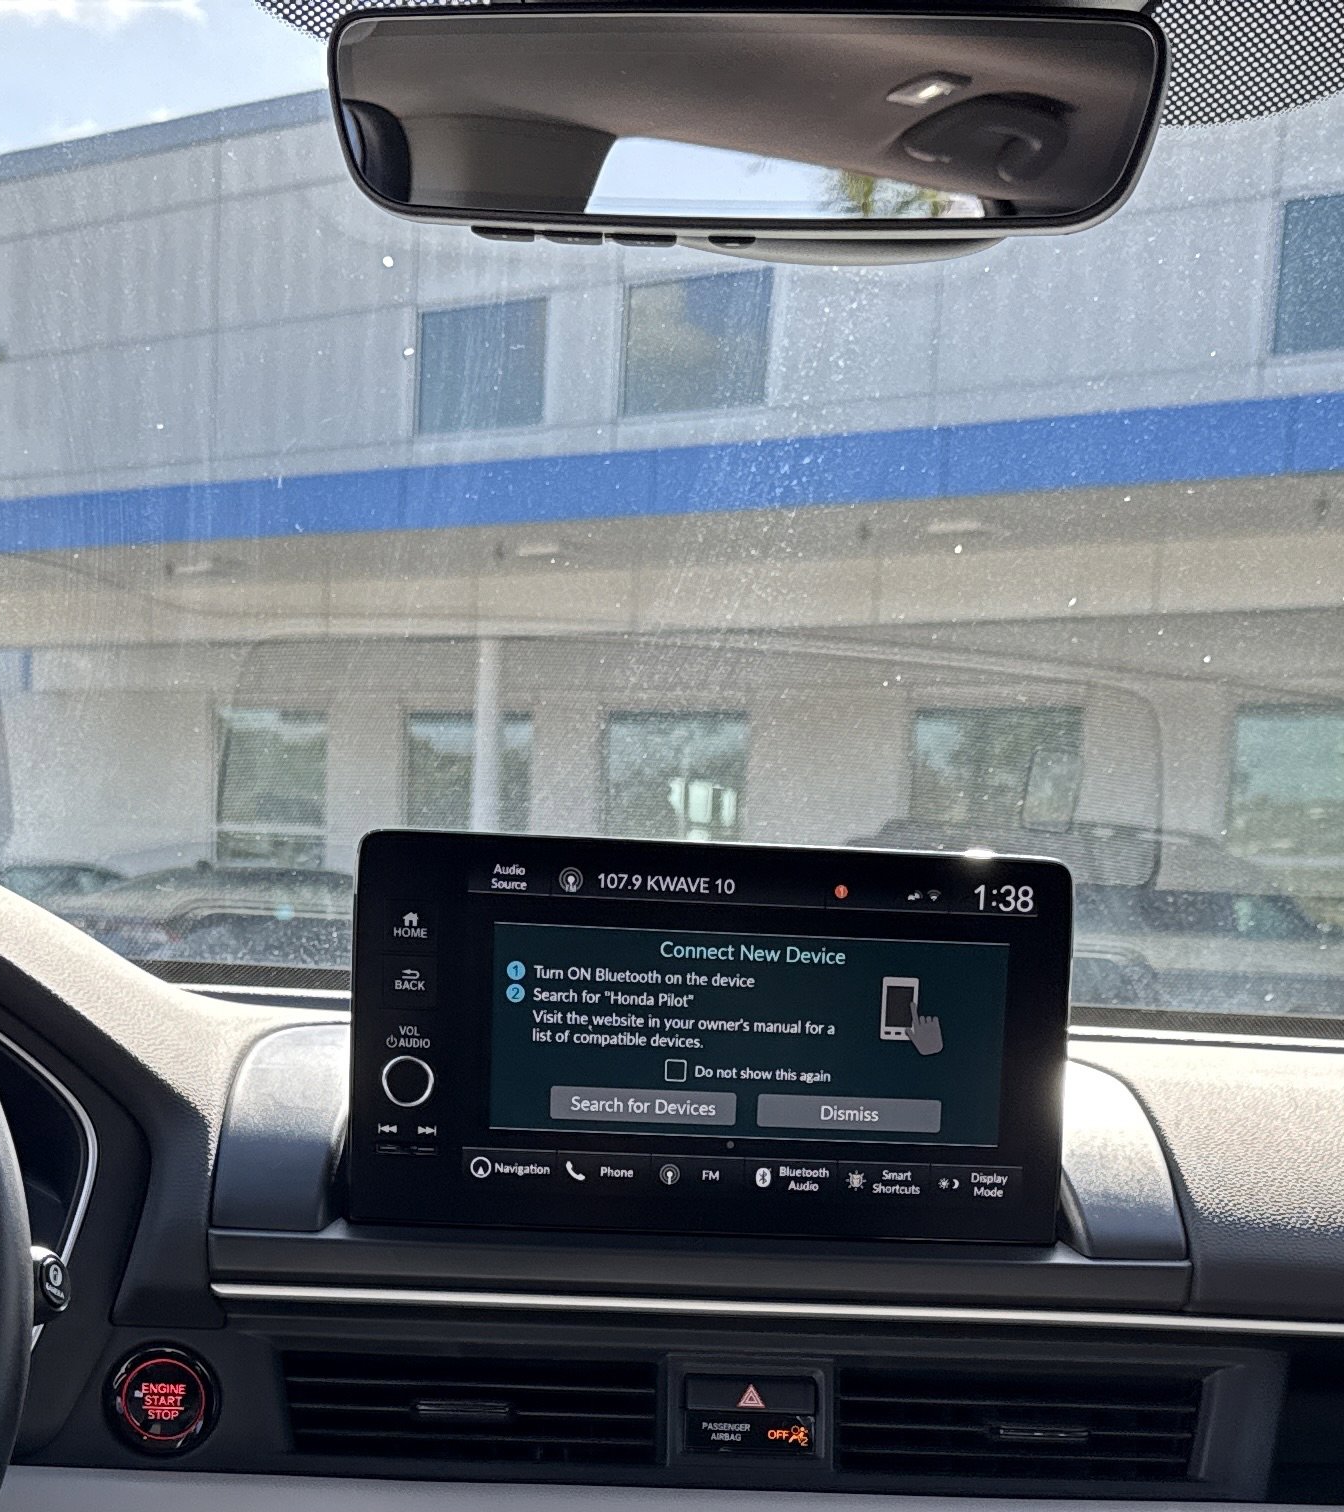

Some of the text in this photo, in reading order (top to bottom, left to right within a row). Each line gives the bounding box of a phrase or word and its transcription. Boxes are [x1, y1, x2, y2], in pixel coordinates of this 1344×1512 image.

[493, 863, 526, 876] Audio
[490, 878, 528, 891] Source
[597, 873, 736, 895] 107.9 KWAVE 10
[973, 884, 1034, 913] 1:38
[392, 927, 428, 939] HOME
[659, 941, 847, 966] Connect New Device
[533, 965, 564, 981] Turn
[567, 966, 592, 982] ON
[595, 967, 662, 984] Bluetooth
[664, 972, 683, 985] on
[686, 971, 708, 986] the
[711, 973, 756, 989] device
[394, 979, 426, 992] BACK
[533, 987, 579, 1004] Search
[581, 989, 602, 1004] for
[604, 990, 655, 1007] "Honda
[658, 992, 695, 1009] Pilot"
[532, 1009, 836, 1036] Visit the website in your owner's manual for a
[398, 1025, 421, 1037] VOL
[397, 1037, 431, 1049] AUDIO
[531, 1028, 704, 1049] list of compatible devices.
[694, 1065, 831, 1084] Do not show this again
[570, 1096, 716, 1117] Search for Devices
[819, 1104, 879, 1123] Dismiss
[494, 1162, 551, 1178] Navigation
[599, 1165, 634, 1179] Phone
[701, 1169, 720, 1181] FM
[778, 1165, 830, 1179] Bluetooth
[881, 1168, 912, 1182] Smart
[787, 1179, 819, 1192] Audio
[970, 1172, 1009, 1187] Display
[871, 1182, 921, 1196] Shortcuts
[972, 1186, 1004, 1198] Mode
[141, 1382, 187, 1395] ENGINE
[144, 1395, 183, 1407] START
[147, 1409, 179, 1420] STOP
[701, 1422, 751, 1432] PASSENGER
[710, 1432, 742, 1442] AIRBAG
[767, 1429, 790, 1441] OFF
